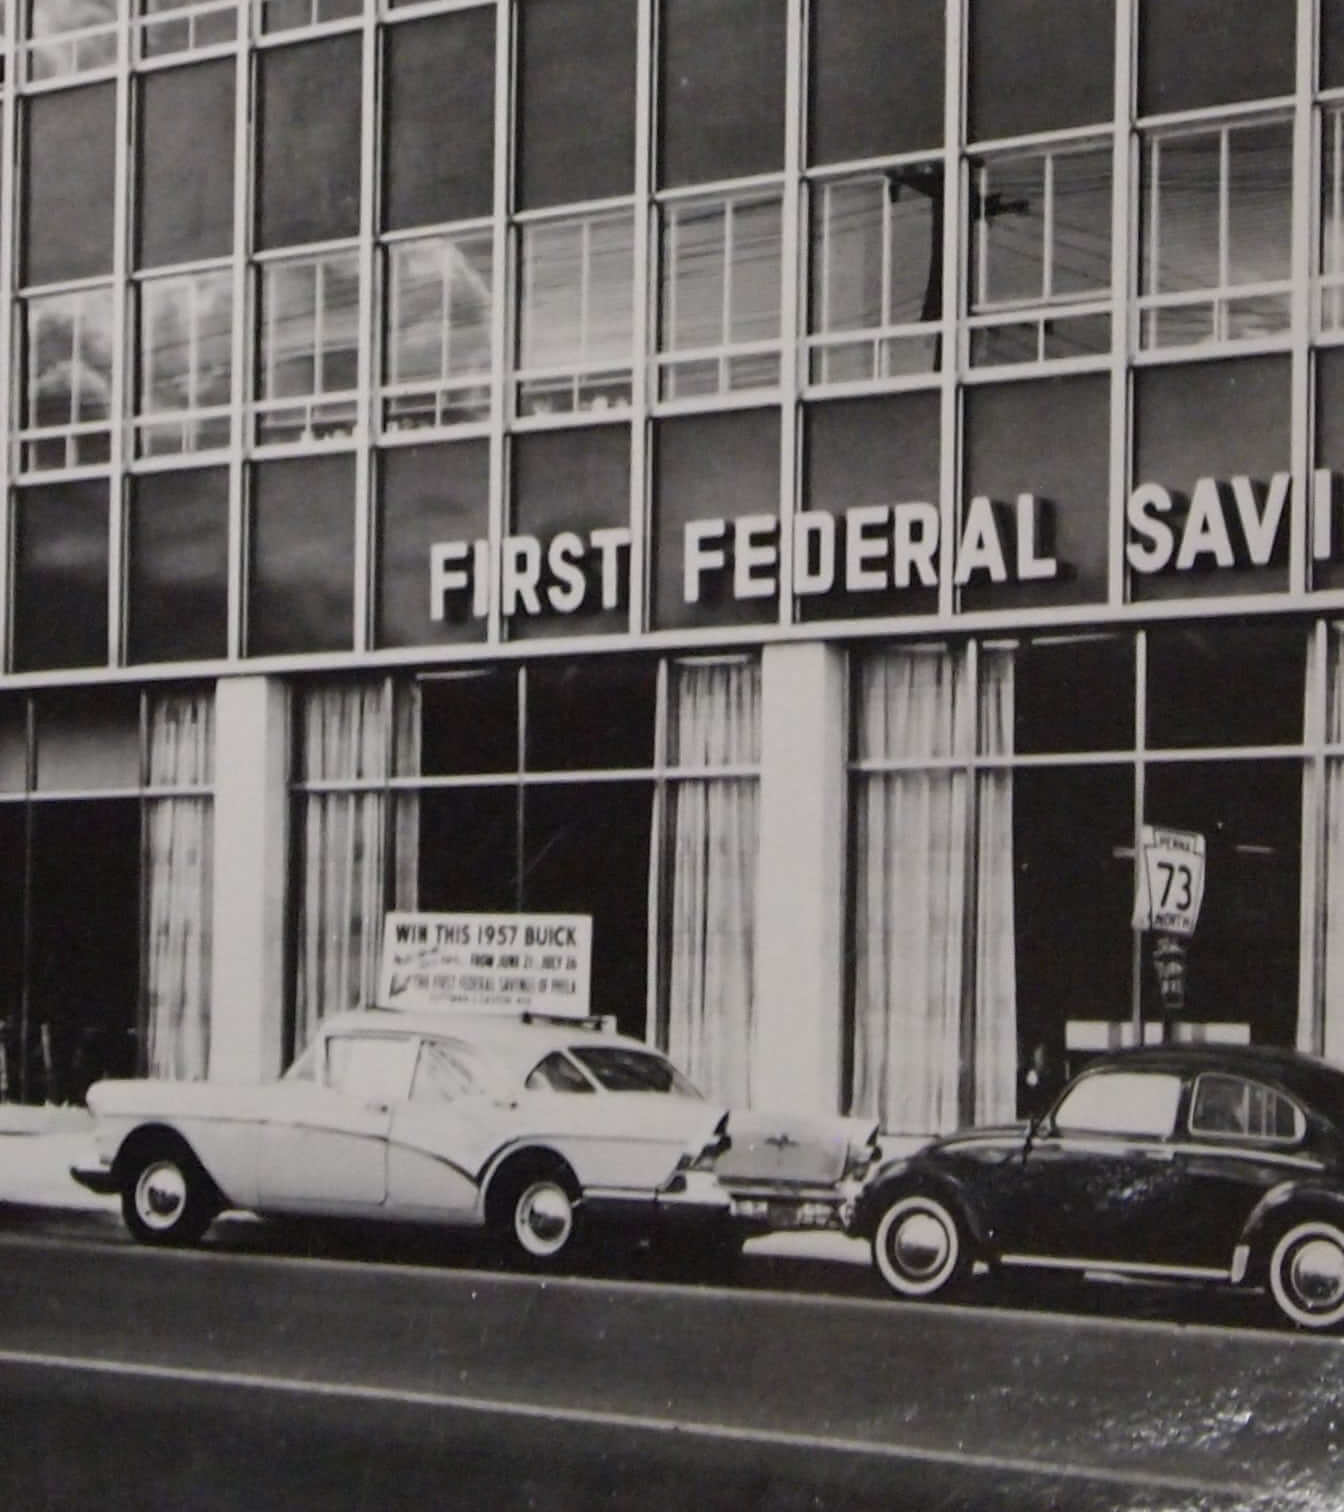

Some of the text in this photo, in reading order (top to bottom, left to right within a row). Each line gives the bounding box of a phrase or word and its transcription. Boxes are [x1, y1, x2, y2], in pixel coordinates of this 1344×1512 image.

[428, 526, 634, 622] FIRST
[681, 491, 1059, 605] FEDERAL
[1156, 860, 1193, 912] 73
[395, 923, 577, 948] WIN THIS 1957 BUICK
